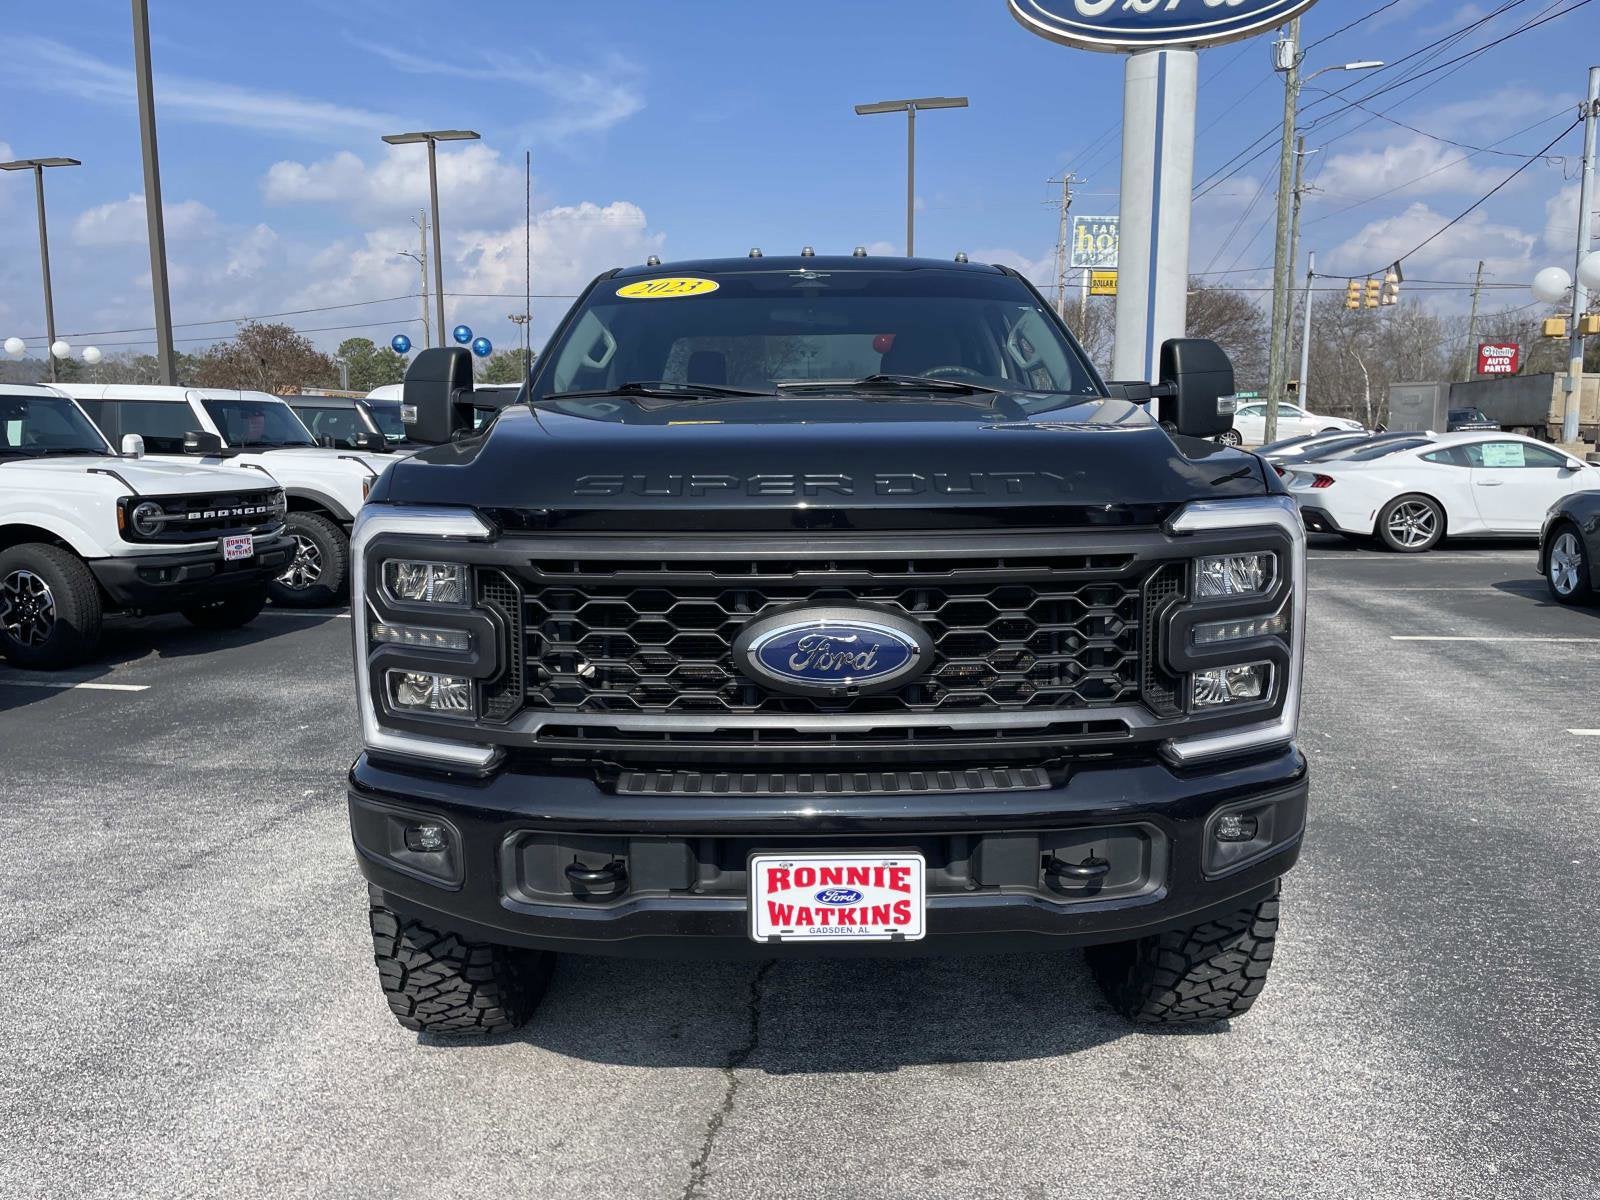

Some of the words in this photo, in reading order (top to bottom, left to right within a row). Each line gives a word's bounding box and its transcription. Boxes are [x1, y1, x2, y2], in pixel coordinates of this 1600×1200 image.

[628, 280, 704, 295] 2023
[1484, 364, 1512, 373] PARTS
[1486, 357, 1510, 365] AUTO
[572, 474, 855, 498] SUPER
[874, 470, 1087, 496] DUTY
[188, 505, 267, 520] BRONCO
[225, 537, 251, 548] RONNIE
[226, 546, 252, 557] WATKINS
[788, 633, 880, 672] Ford
[766, 866, 911, 894] RONNIE
[821, 887, 858, 903] Ford
[766, 899, 912, 927] WATKINS
[808, 926, 856, 935] GADSDEN,
[858, 926, 871, 934] AL
